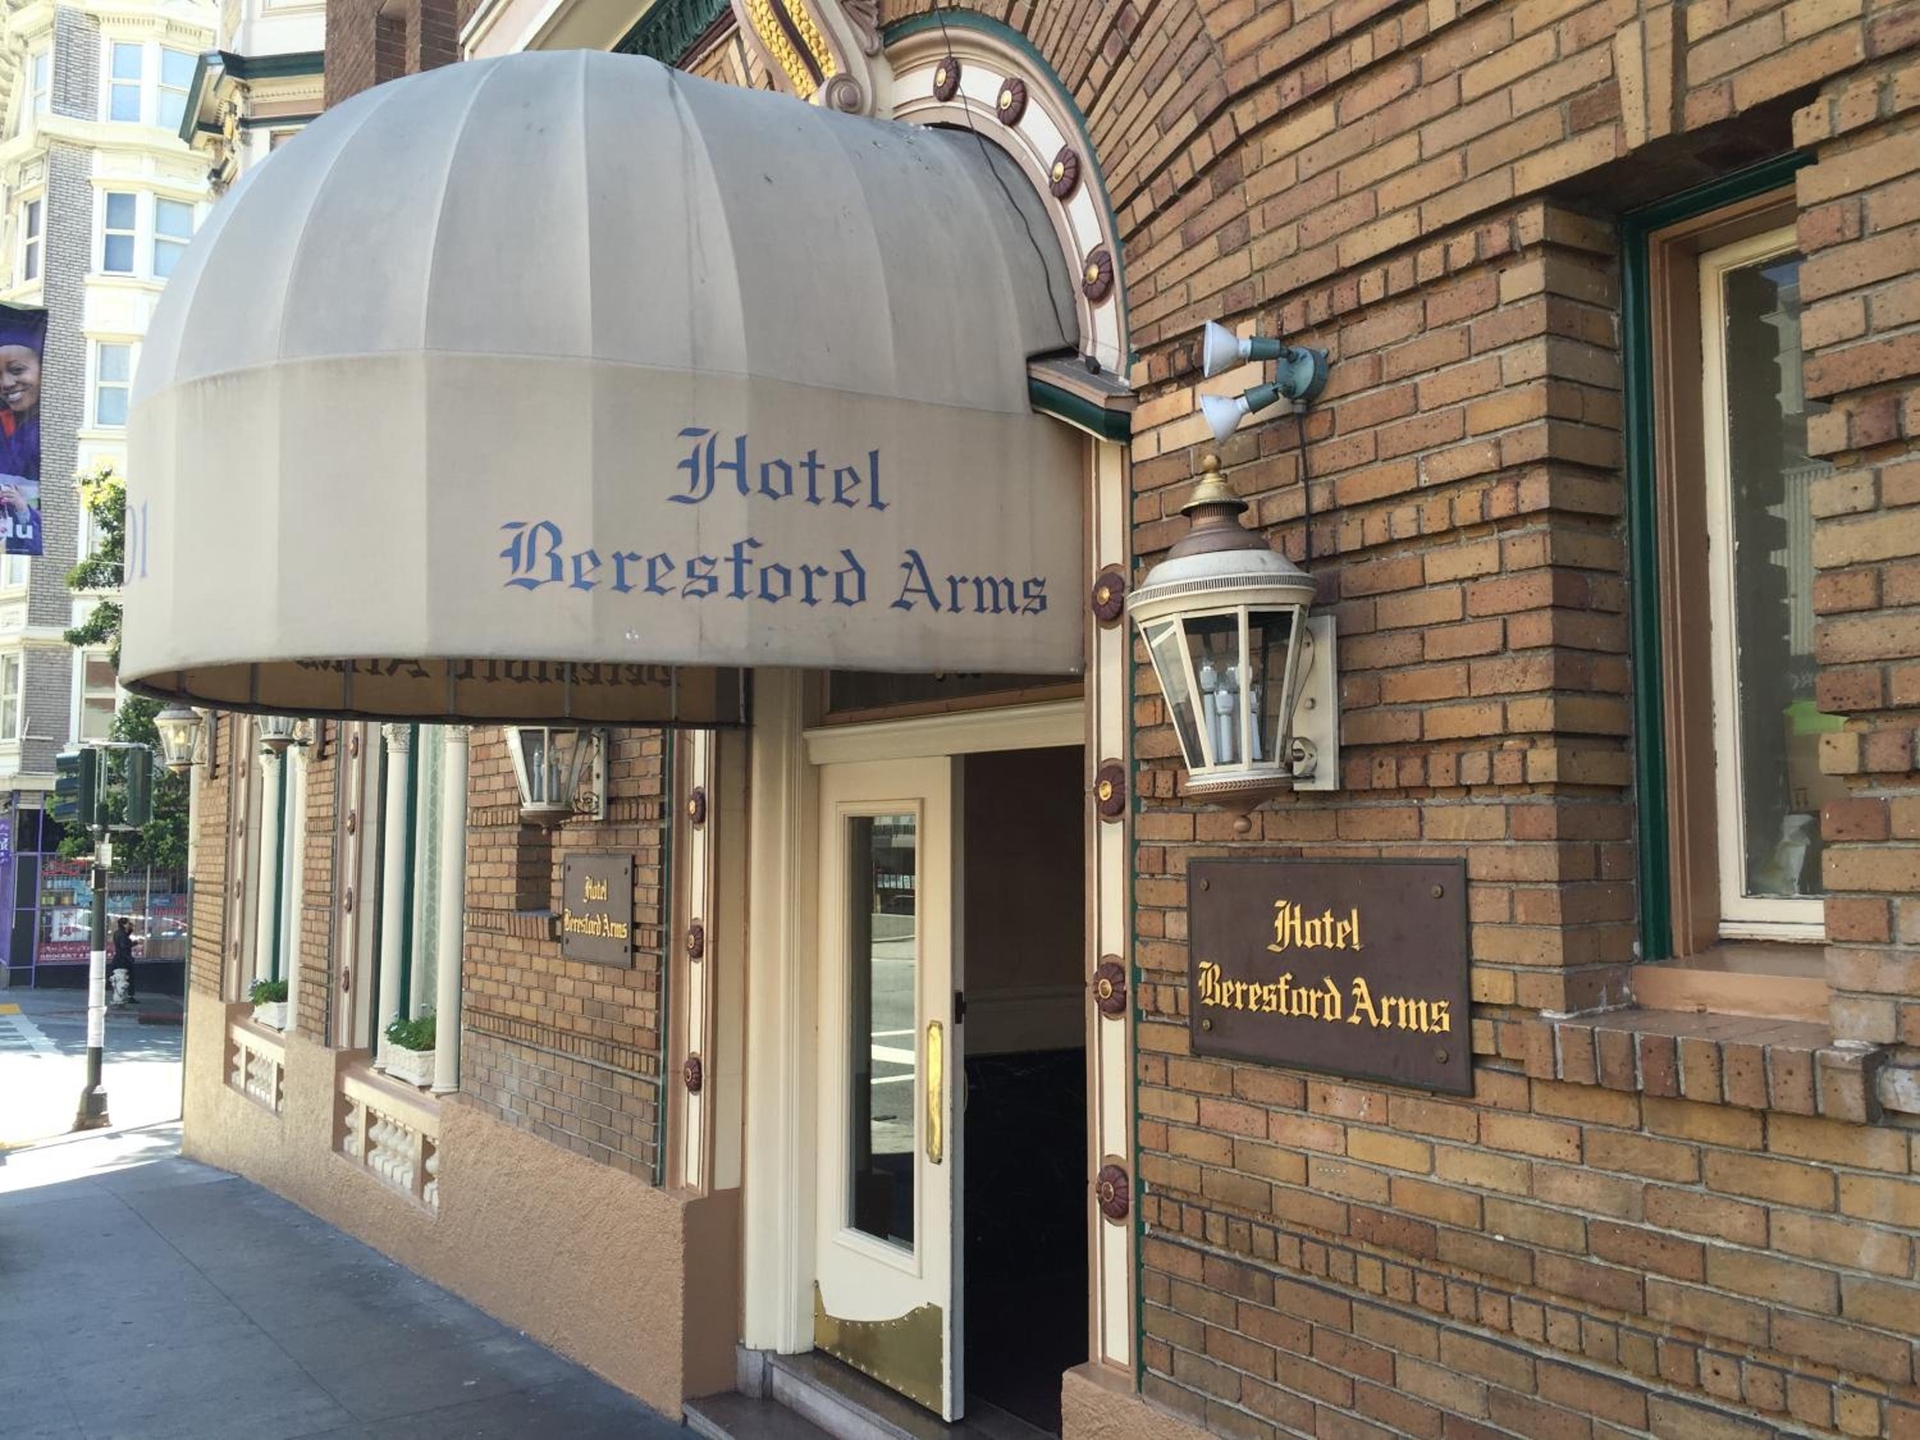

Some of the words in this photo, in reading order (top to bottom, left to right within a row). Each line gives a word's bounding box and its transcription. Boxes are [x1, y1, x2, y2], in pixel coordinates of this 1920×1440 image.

[667, 427, 890, 511] Hotel
[499, 519, 867, 606] Beresford
[890, 549, 1048, 616] Arms
[1267, 899, 1364, 952] Hotel
[1198, 960, 1343, 1022] Beresford
[1347, 976, 1451, 1033] Arms
